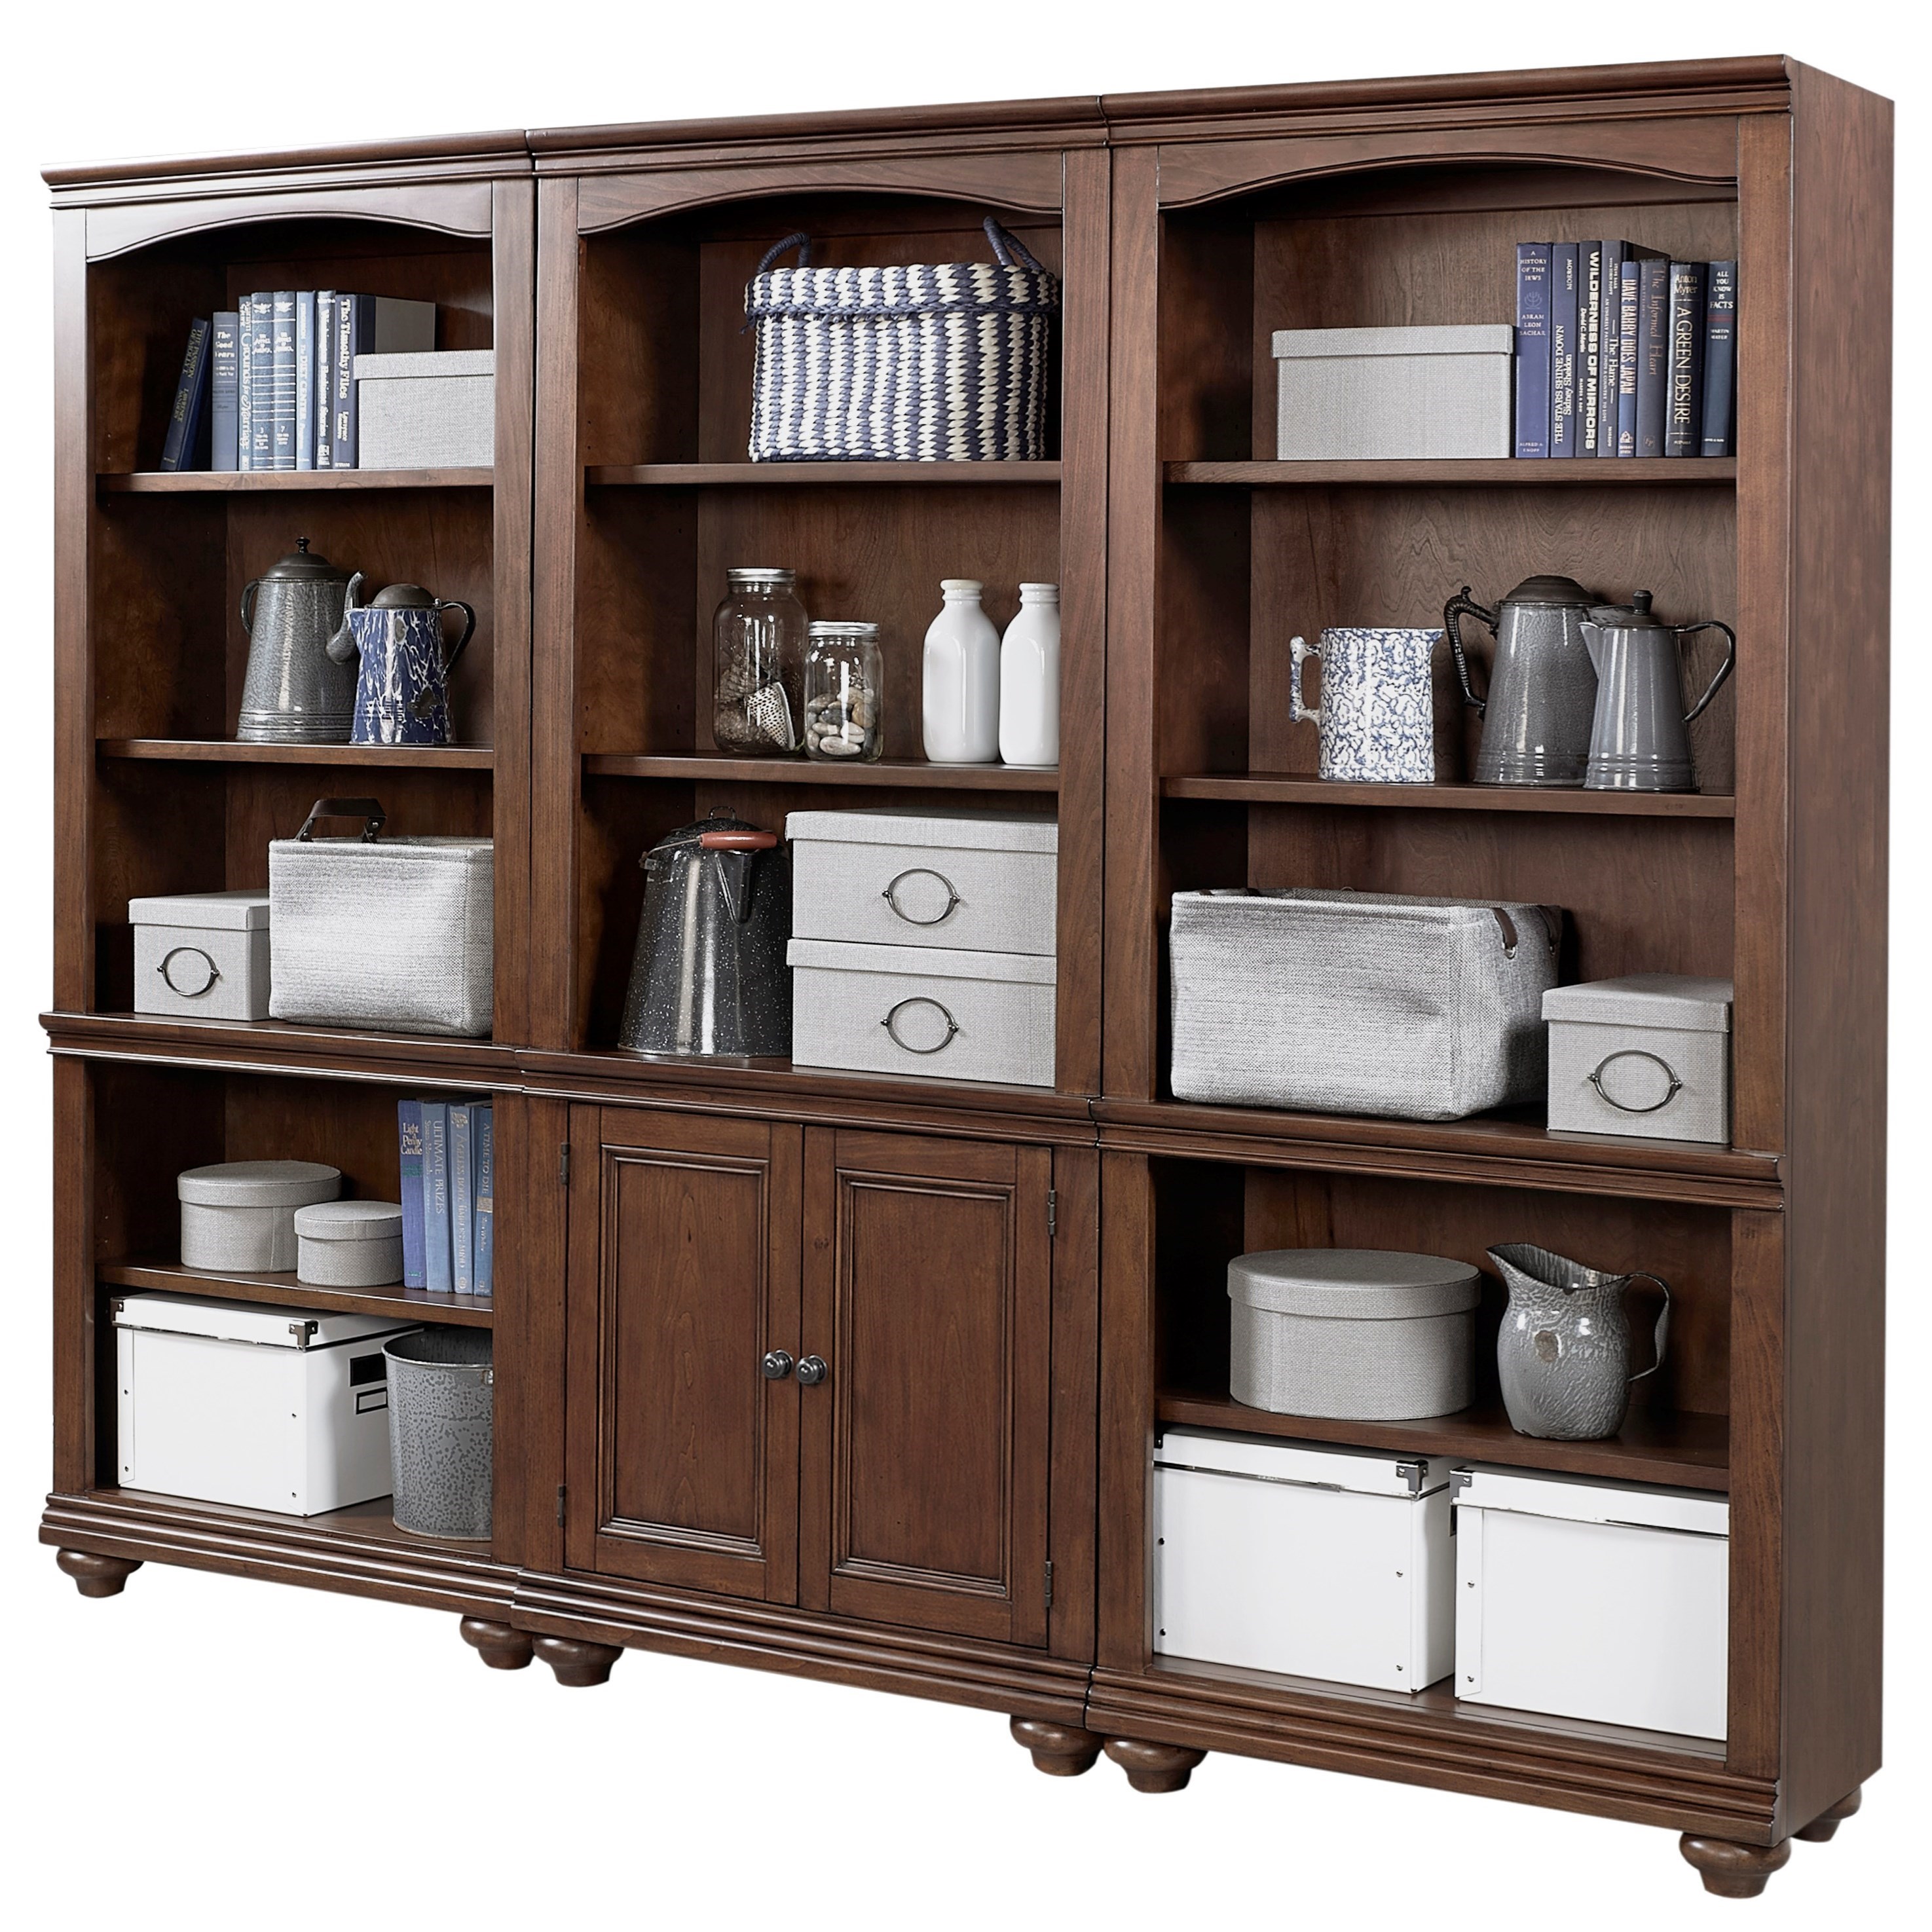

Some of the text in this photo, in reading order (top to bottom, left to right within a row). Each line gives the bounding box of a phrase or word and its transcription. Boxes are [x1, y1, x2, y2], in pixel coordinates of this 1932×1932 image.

[1673, 284, 1698, 295] Myrer
[1675, 274, 1697, 284] Anton
[1647, 265, 1667, 375] The Informed Heart
[1677, 307, 1692, 318] A
[339, 299, 350, 399] The Timothy Files
[1555, 325, 1564, 356] DOWN
[1585, 251, 1599, 449] WILDERNESS OF MIRRORS
[1620, 279, 1637, 394] DAVE BARRY DOES JAPAN
[1676, 320, 1693, 368] GREEN
[1608, 336, 1619, 386] The Flame
[1563, 354, 1573, 416] Sidney Sheldon
[1674, 375, 1692, 424] DESIRE
[240, 394, 251, 450] Marriage
[1555, 390, 1563, 422] STARS
[1555, 422, 1563, 445] THE
[402, 1134, 422, 1147] Penny
[403, 1123, 419, 1134] Light
[400, 1145, 422, 1155] Candle
[433, 1120, 445, 1214] ULTIMATE PRIZES
[482, 1159, 490, 1174] TO
